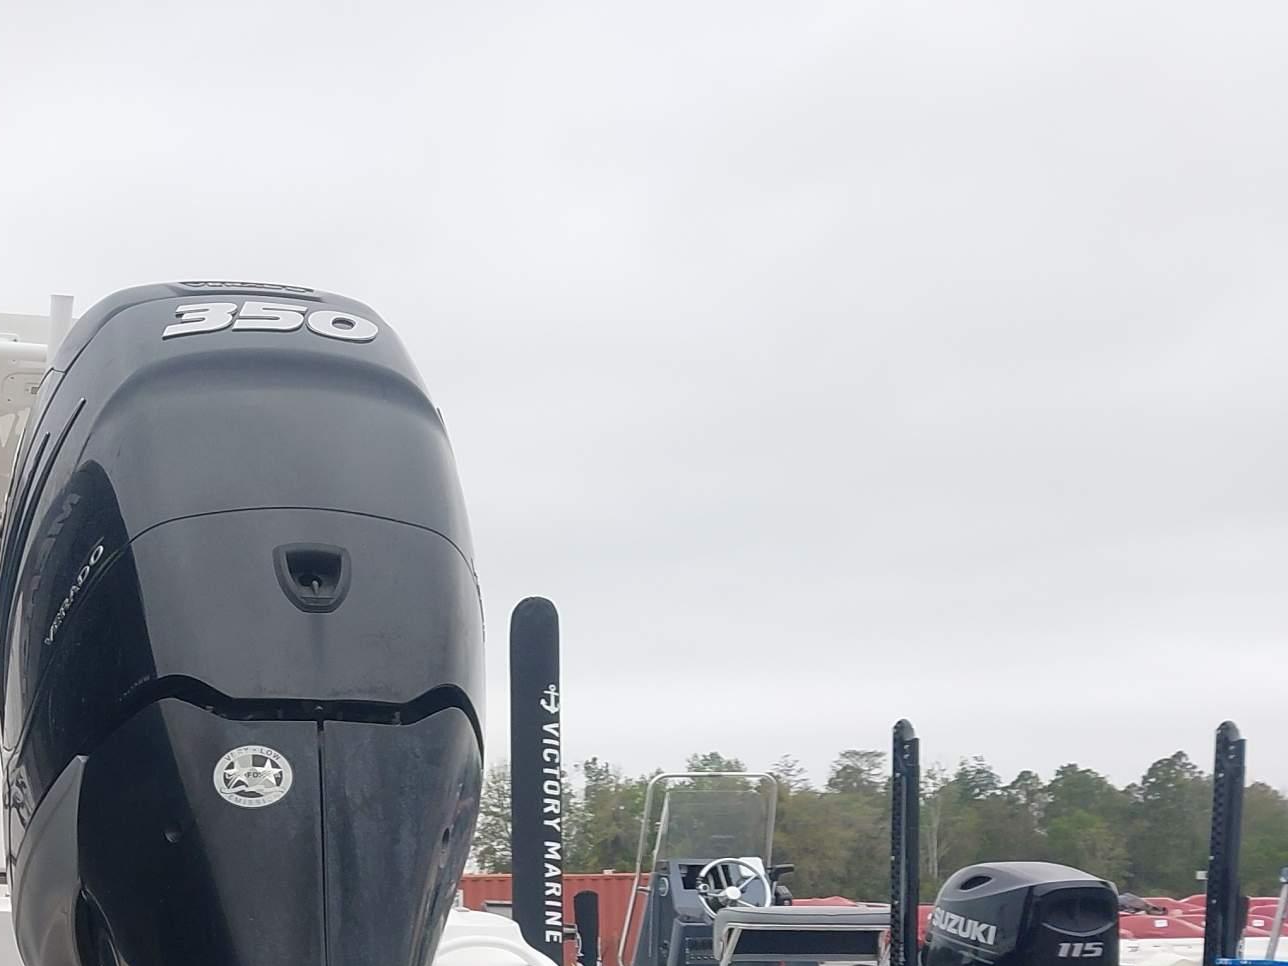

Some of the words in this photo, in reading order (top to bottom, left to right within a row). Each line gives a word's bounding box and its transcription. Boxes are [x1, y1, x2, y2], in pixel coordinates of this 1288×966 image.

[161, 302, 380, 344] 350
[541, 722, 562, 833] VICTORY
[543, 841, 563, 945] MARINE
[931, 907, 997, 945] SUZUKI
[1056, 942, 1104, 958] 115
